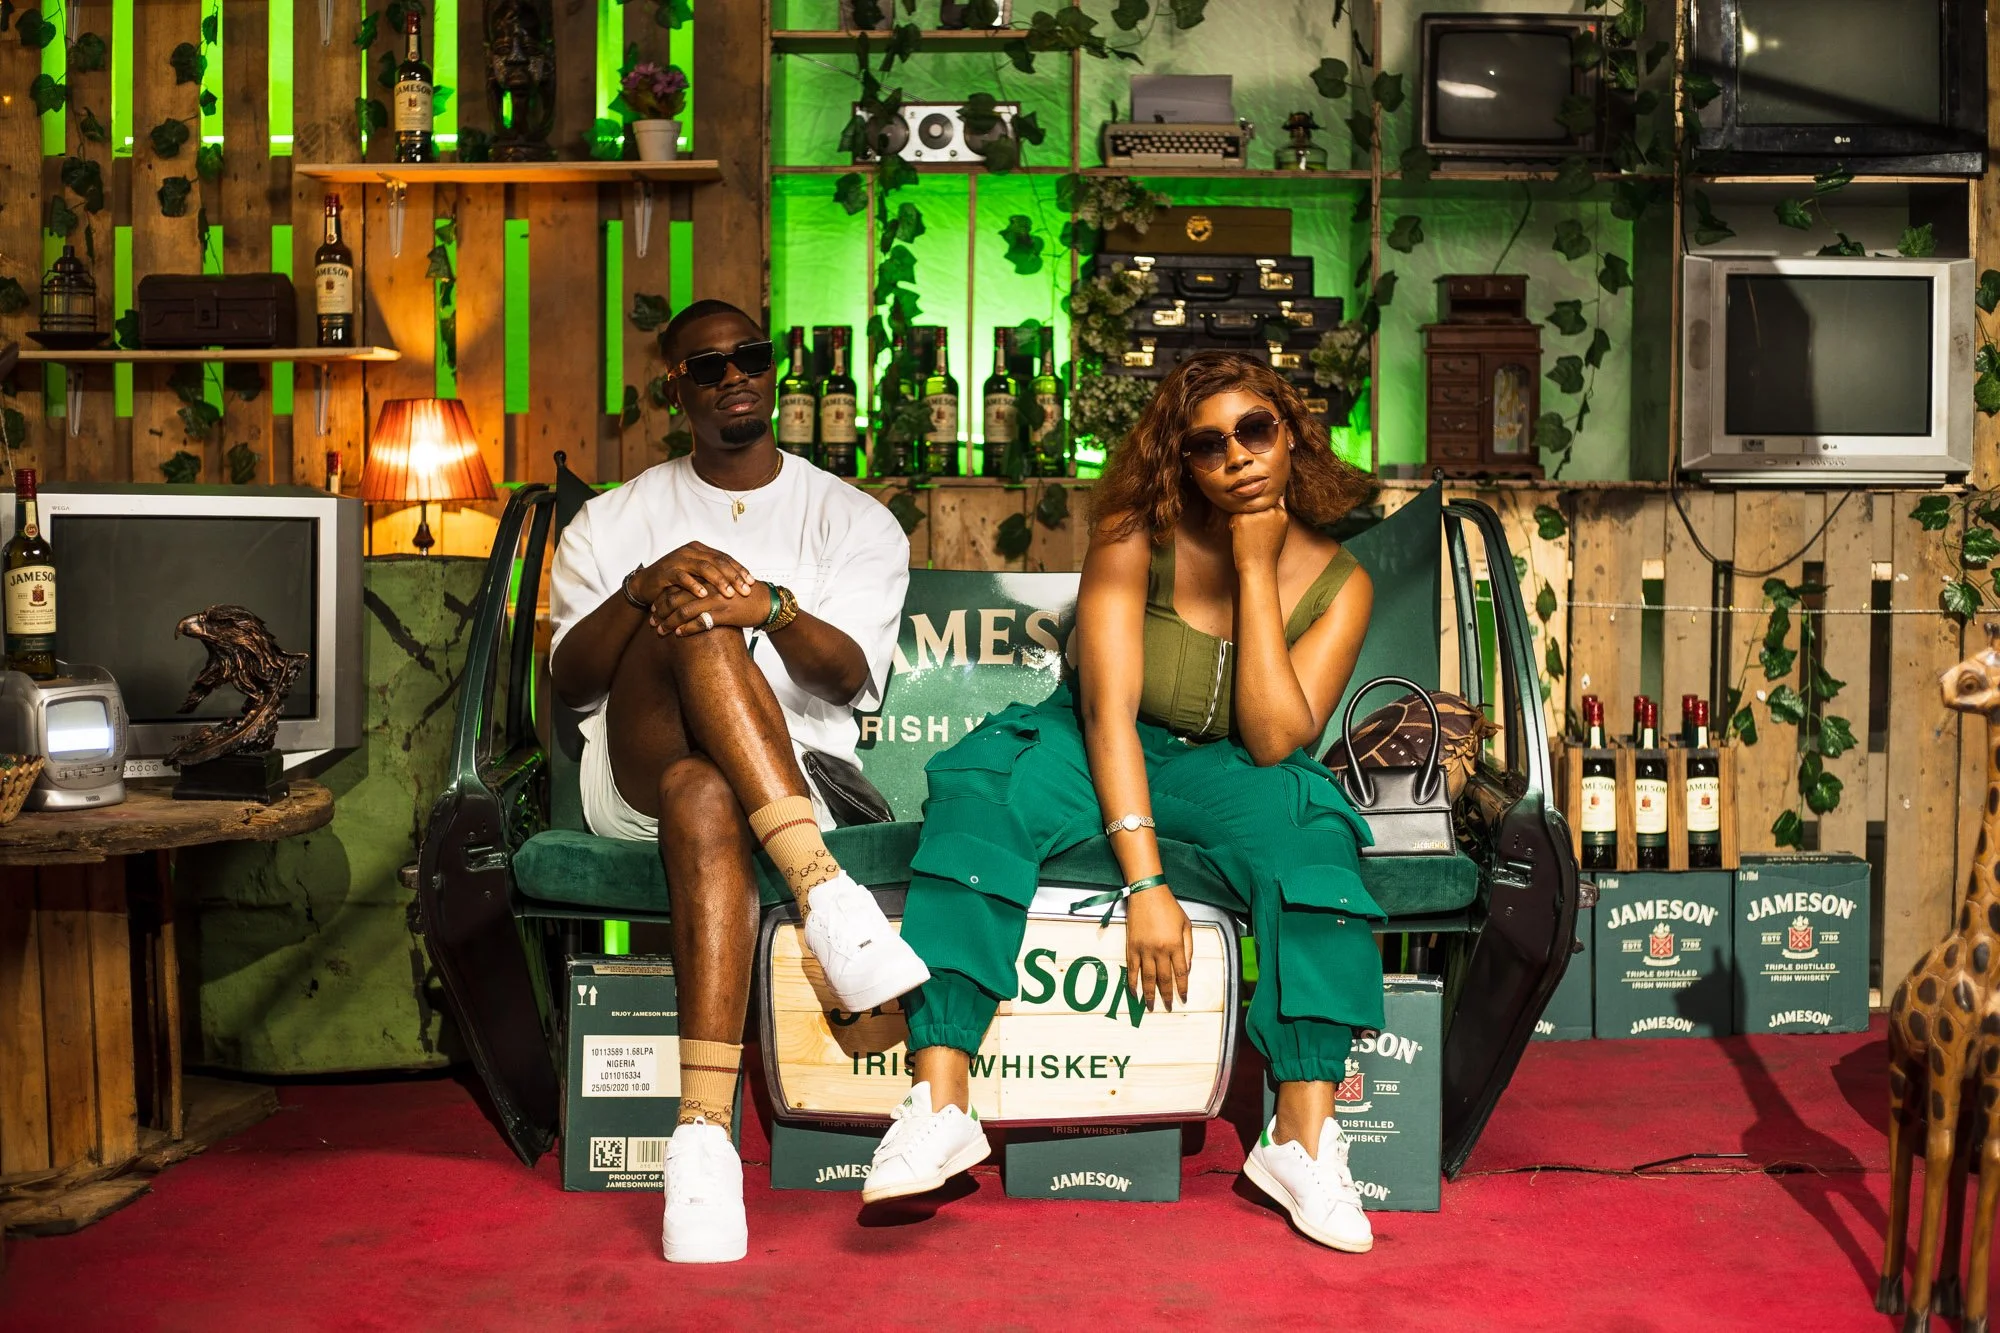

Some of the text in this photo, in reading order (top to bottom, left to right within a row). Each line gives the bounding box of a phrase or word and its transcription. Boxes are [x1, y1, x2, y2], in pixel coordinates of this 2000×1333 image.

[892, 608, 1078, 676] MES
[1412, 841, 1447, 850] JACQUEMUS
[1747, 892, 1855, 922] JAMESON
[1607, 899, 1716, 930] JAMESON
[1765, 963, 1793, 971] TRIPLE
[1626, 969, 1698, 978] TRIPLE DISTILLED
[1795, 974, 1831, 982] WHISKEY
[1631, 981, 1692, 989] IRISH WHISKEY
[1769, 1009, 1831, 1028] JAMESON
[1630, 1016, 1694, 1035] JAMESON
[591, 1047, 654, 1057] 10113589 1.68LPA
[606, 1060, 636, 1068] NIGERIA
[968, 1054, 1132, 1080] WHISKEY
[600, 1072, 641, 1080] L011016334
[591, 1082, 650, 1092] 25/05/2020 10:00
[1375, 1083, 1398, 1092] 1780
[1342, 1119, 1395, 1129] DISTILLED
[1053, 1126, 1129, 1136] IRISH WHISKEY
[1050, 1171, 1129, 1193] JAMESON
